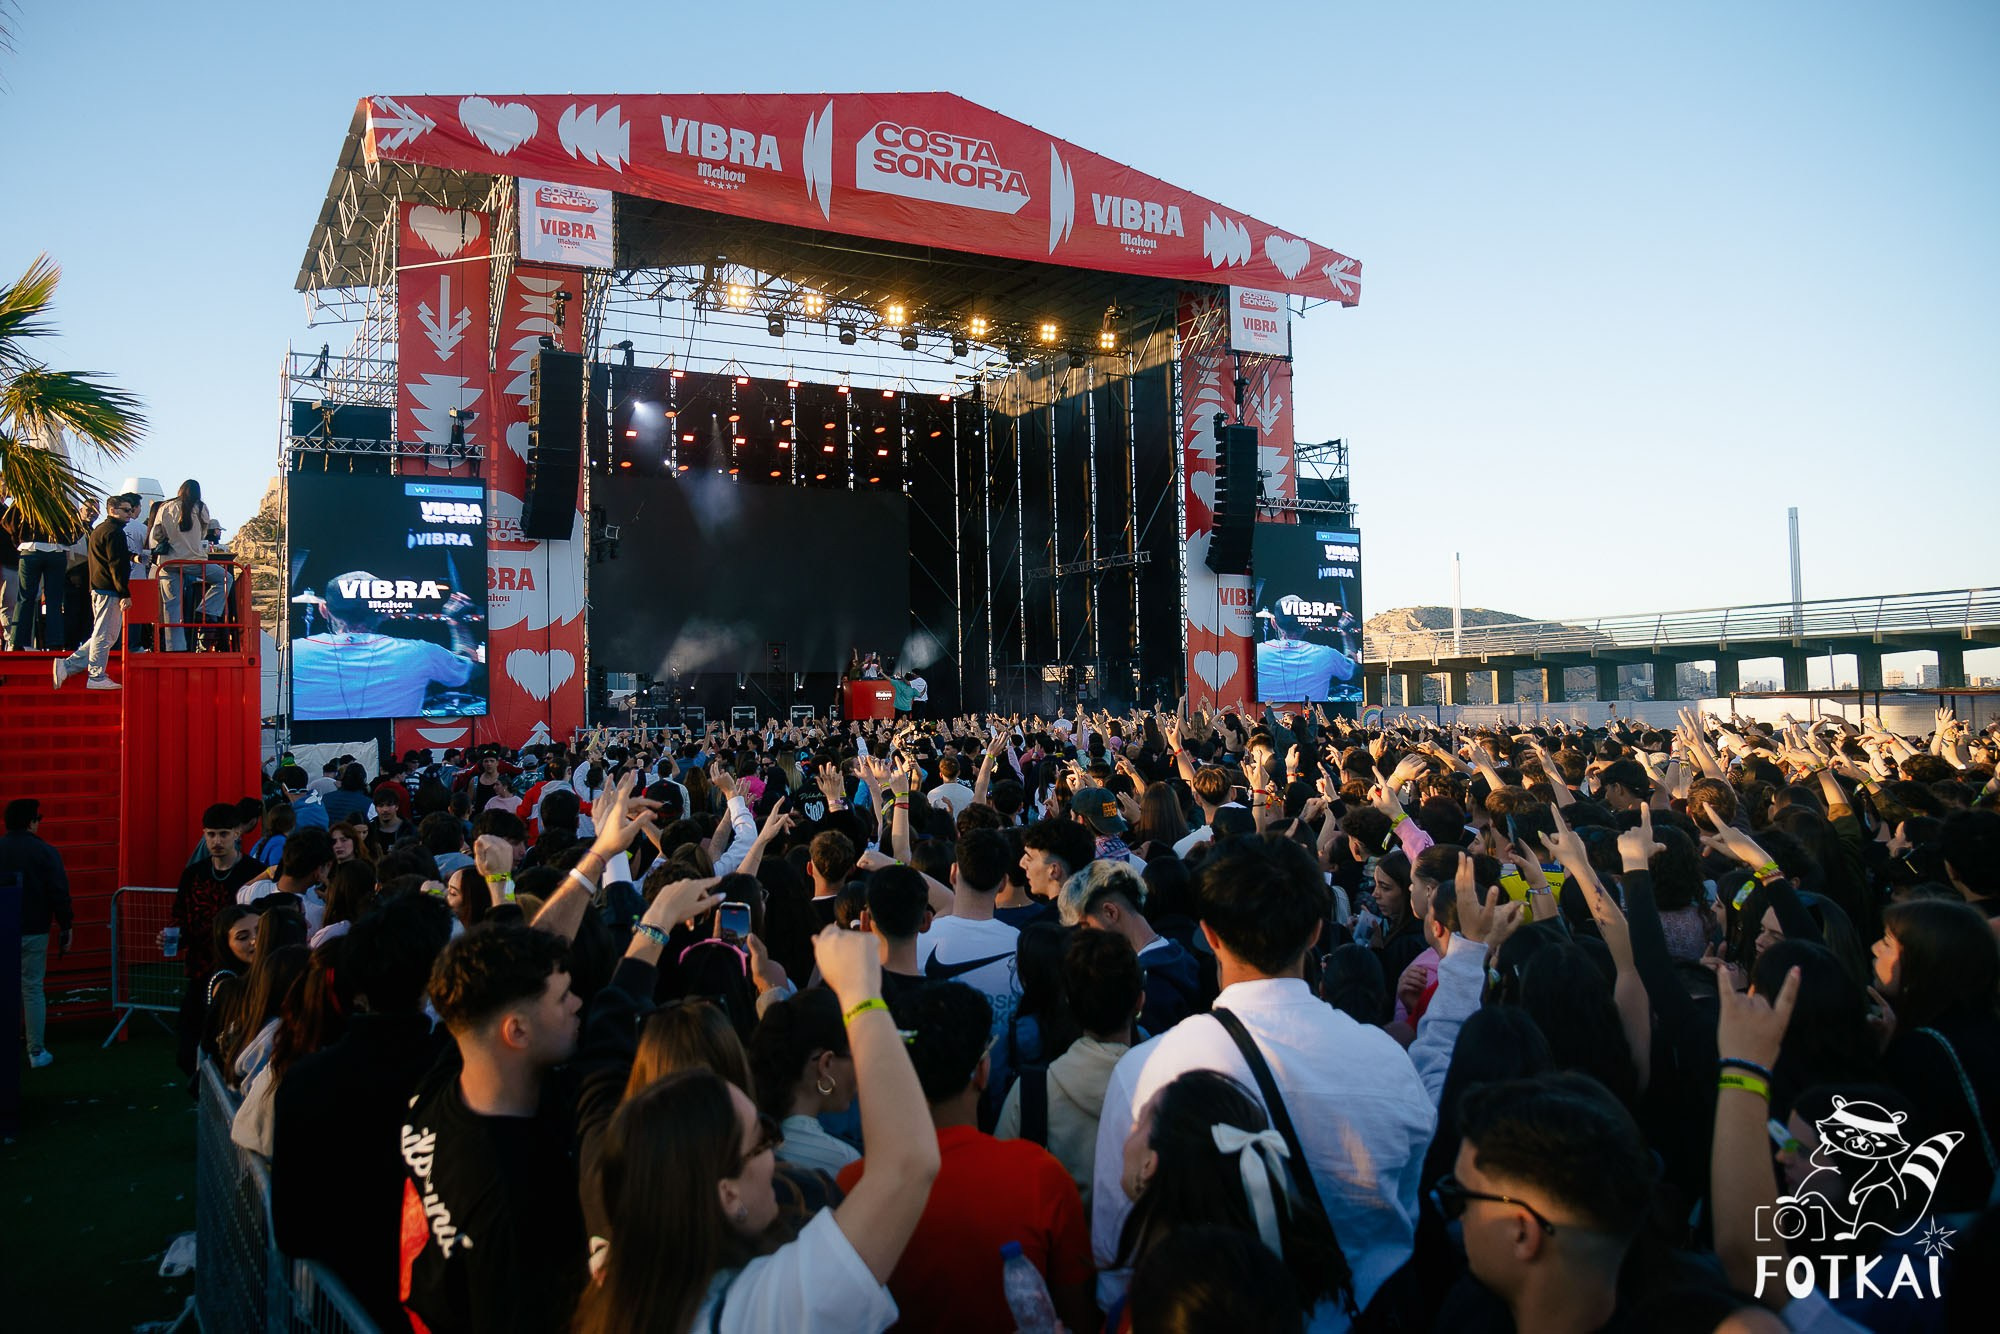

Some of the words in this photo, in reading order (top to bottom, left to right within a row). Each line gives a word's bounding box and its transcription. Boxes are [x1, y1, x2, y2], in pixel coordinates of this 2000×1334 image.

[661, 114, 782, 172] VIBRA
[873, 122, 1001, 167] COSTA
[697, 162, 747, 184] Mahou
[872, 148, 1030, 197] SONORA
[540, 185, 587, 199] COSTA
[540, 193, 599, 209] SONORA
[1091, 193, 1185, 238] VIBRA
[540, 218, 597, 241] VIBRA
[1119, 232, 1158, 250] Mahou
[1243, 291, 1271, 301] COSTA
[1243, 297, 1278, 308] SONORA
[1242, 317, 1278, 334] VIBRA
[420, 501, 483, 518] VIBRA
[487, 518, 522, 529] STA
[416, 532, 473, 547] VIBRA
[488, 567, 536, 591] BRA
[1322, 567, 1355, 578] VIBRA
[338, 580, 441, 599] VIBRA
[488, 593, 511, 602] ahou
[368, 600, 413, 610] Mahou
[1280, 601, 1338, 616] VIBRA
